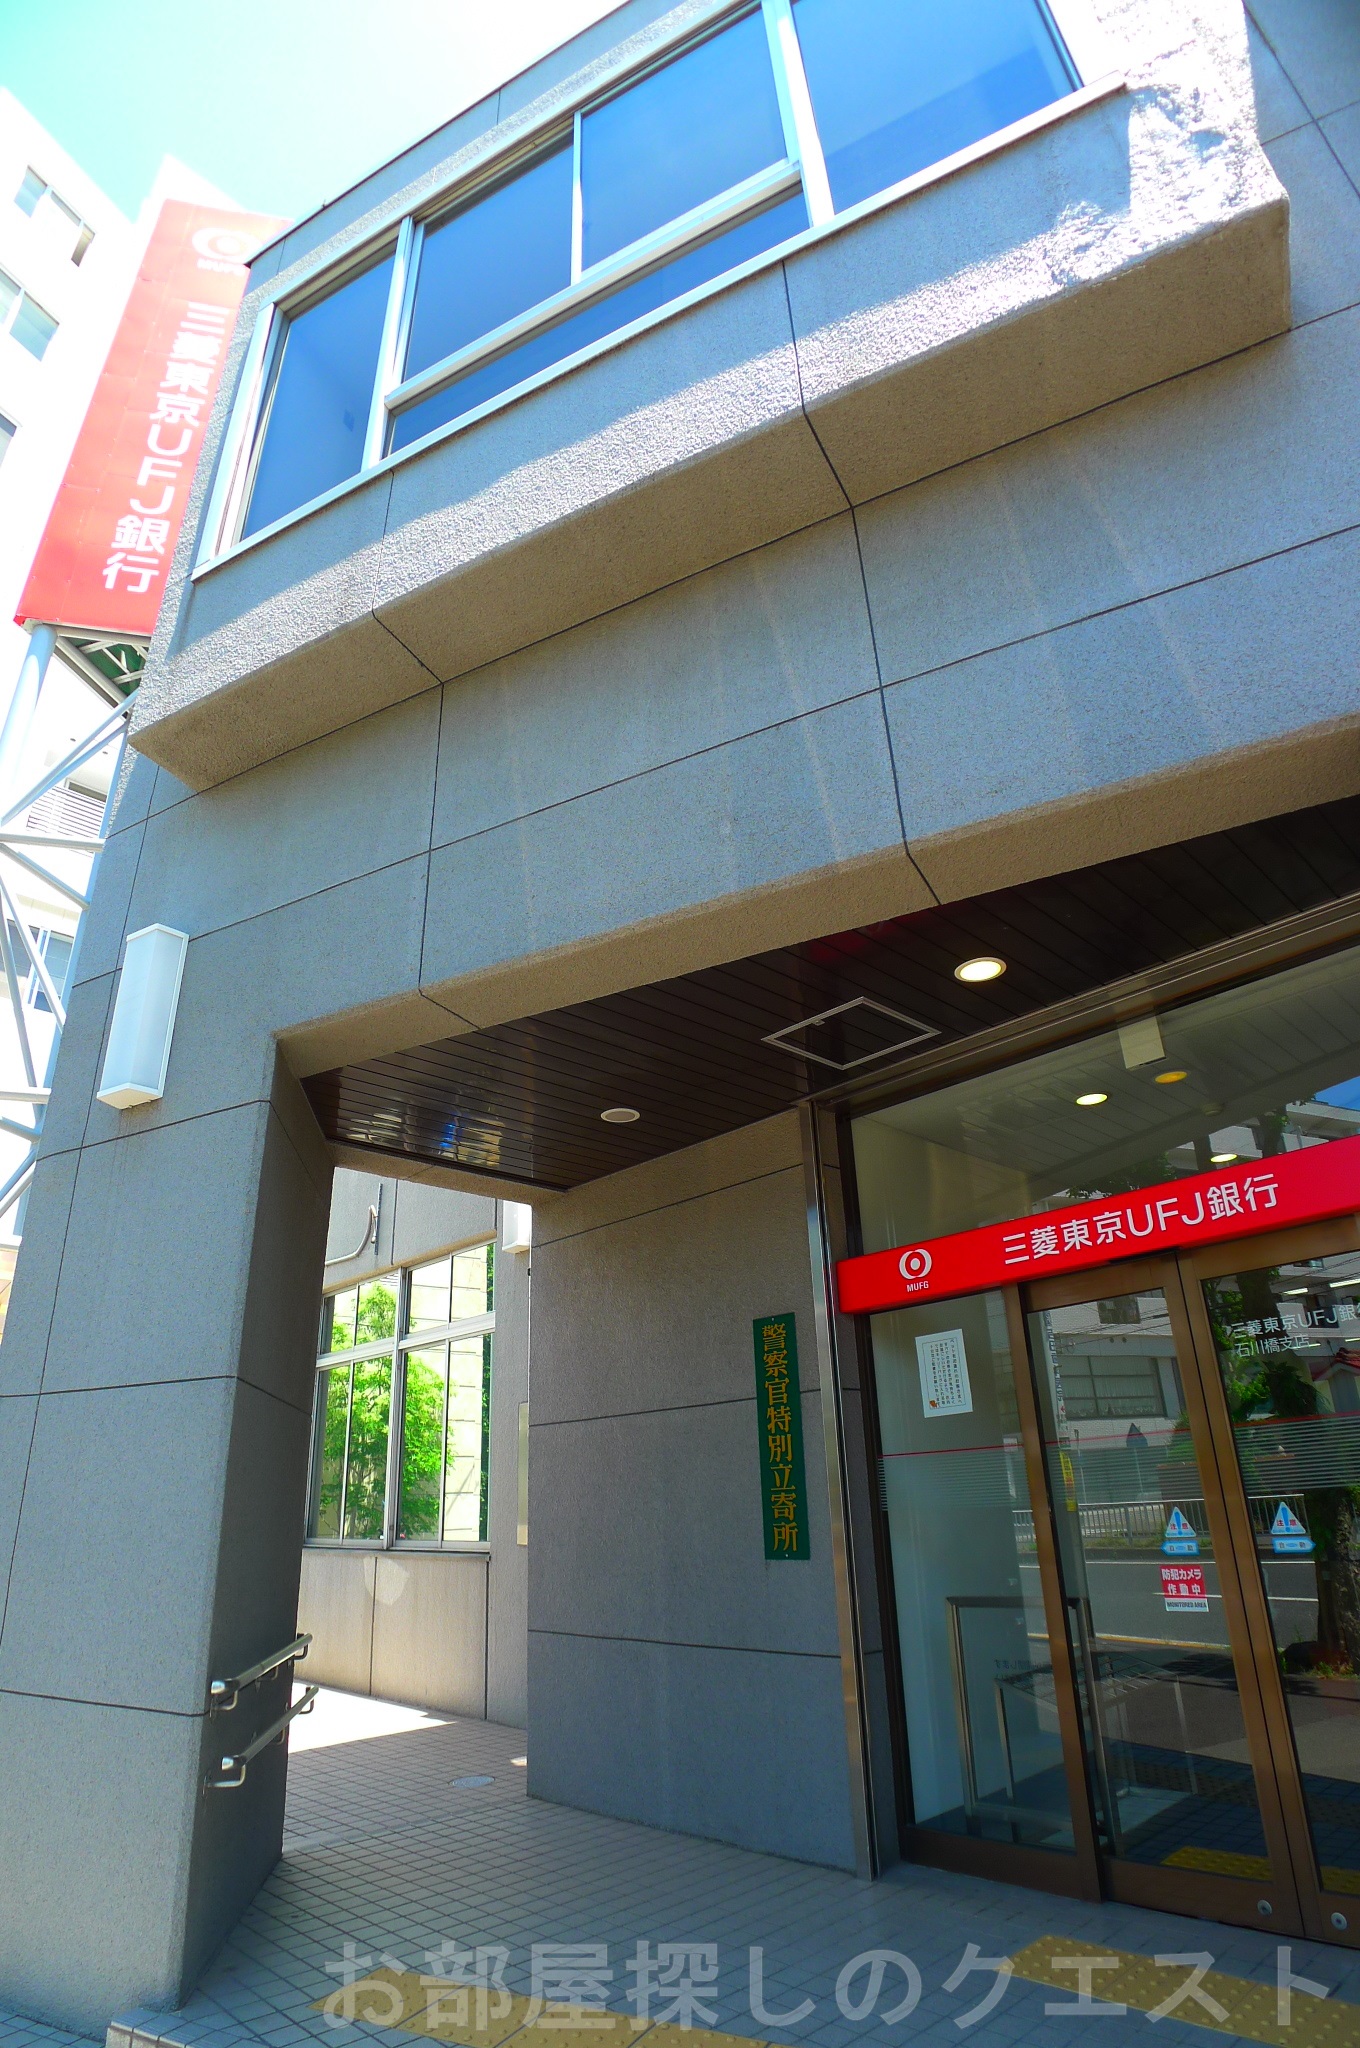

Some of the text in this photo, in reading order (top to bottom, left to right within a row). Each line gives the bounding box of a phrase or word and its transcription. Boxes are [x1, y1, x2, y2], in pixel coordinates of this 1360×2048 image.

[102, 302, 230, 593] 三菱東京UFJ銀行
[1002, 1173, 1279, 1265] 三菱東京UFJ銀行
[906, 1280, 929, 1292] MUFG
[1230, 1302, 1360, 1339] 三菱東京UFJ銀
[1235, 1333, 1310, 1358] 石川橋支店
[762, 1323, 799, 1552] 警察官特別立寄所
[1161, 1568, 1202, 1581] 防犯カメラ
[1167, 1583, 1201, 1596] 作動中
